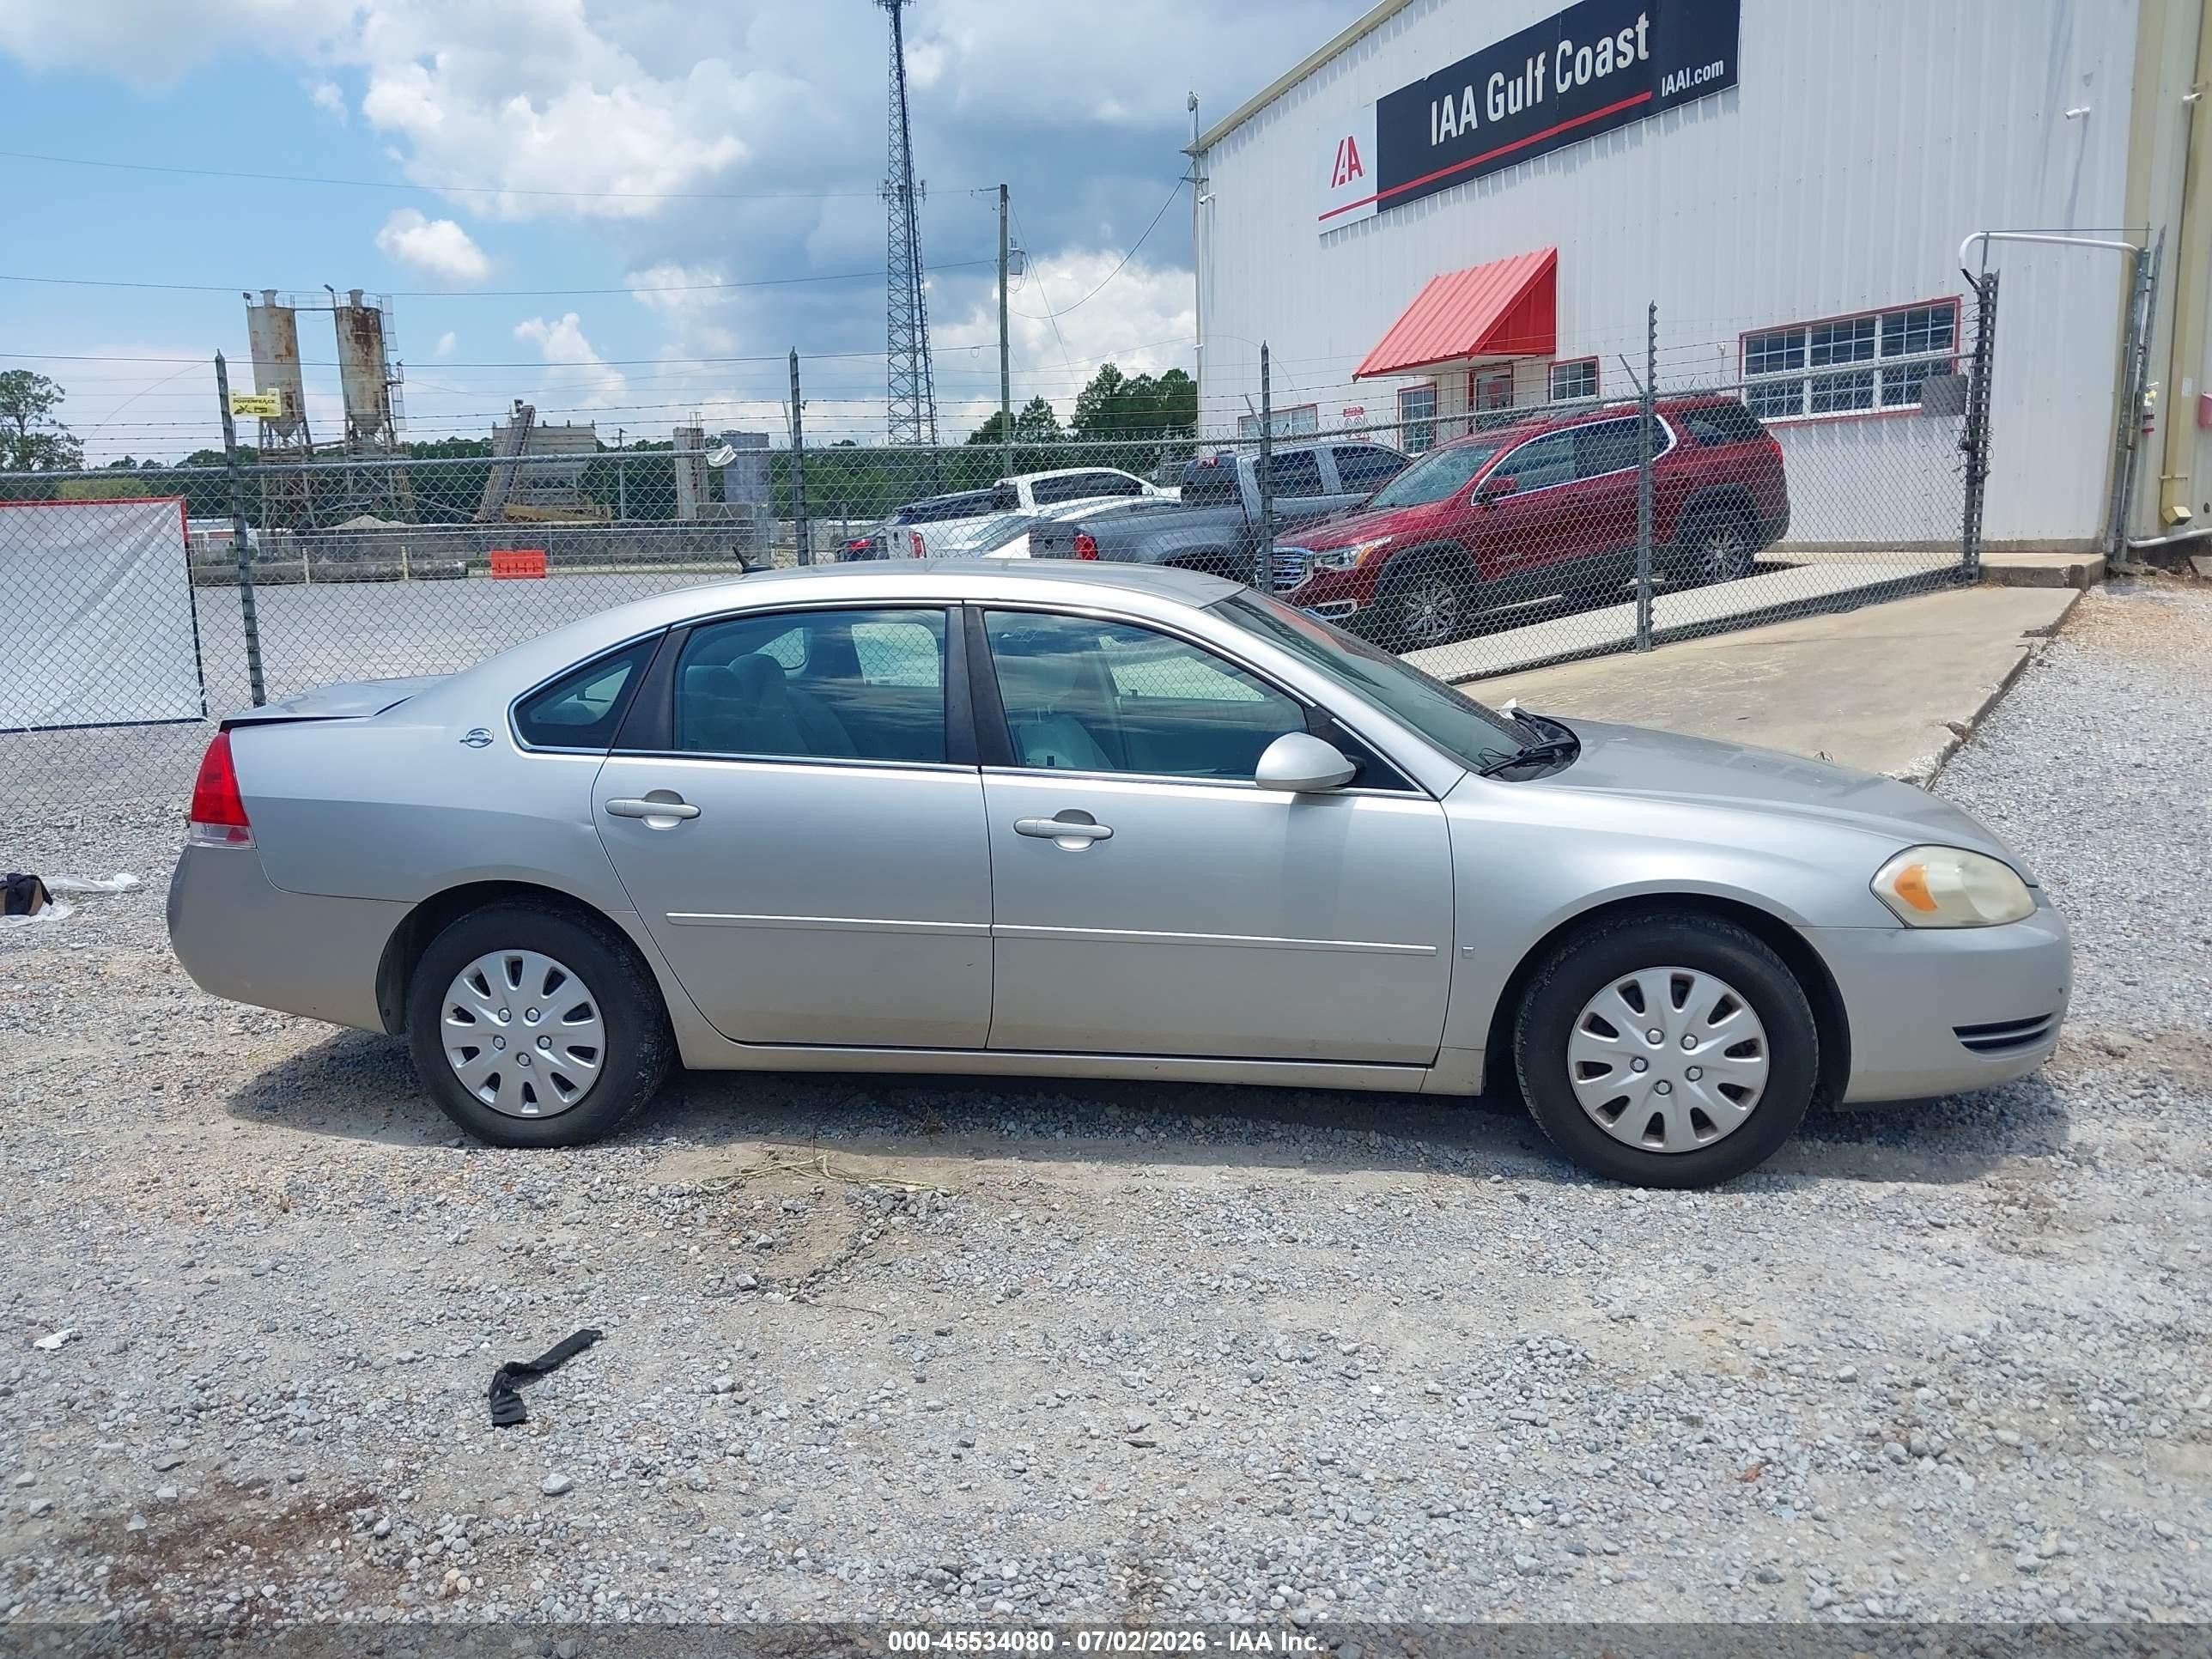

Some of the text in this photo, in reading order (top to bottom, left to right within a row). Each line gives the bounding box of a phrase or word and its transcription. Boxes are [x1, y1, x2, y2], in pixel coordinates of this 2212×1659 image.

[1431, 11, 1650, 146] IAA Gulf Coast
[1662, 59, 1724, 97] IAAI.com
